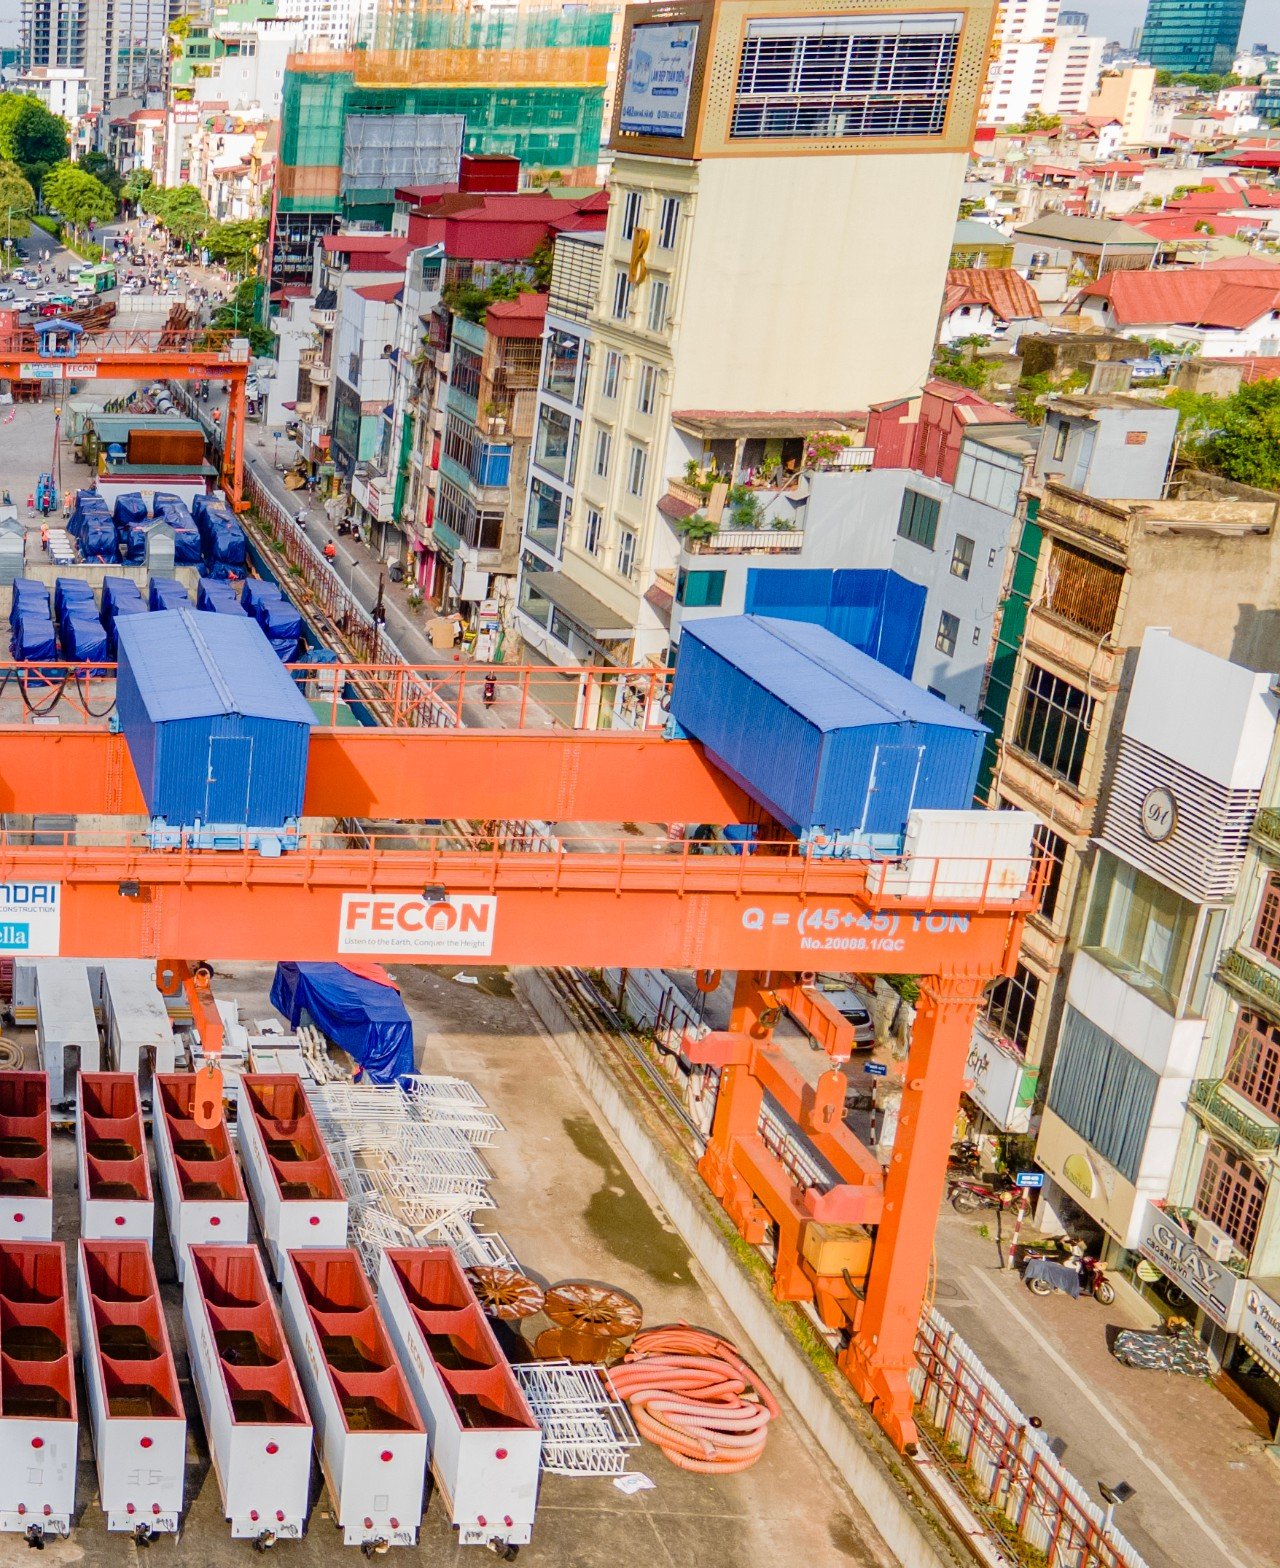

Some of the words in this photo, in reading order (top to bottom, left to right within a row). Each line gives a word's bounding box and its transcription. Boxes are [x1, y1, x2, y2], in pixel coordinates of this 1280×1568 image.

[345, 900, 490, 932] FECON
[741, 907, 766, 930] Q
[772, 913, 790, 926] =
[797, 908, 900, 936] (45+45)
[911, 911, 970, 934] TON
[344, 937, 367, 945] Listen
[377, 937, 390, 946] the
[414, 938, 445, 949] Conquer
[446, 939, 459, 947] the
[460, 940, 485, 949] Height
